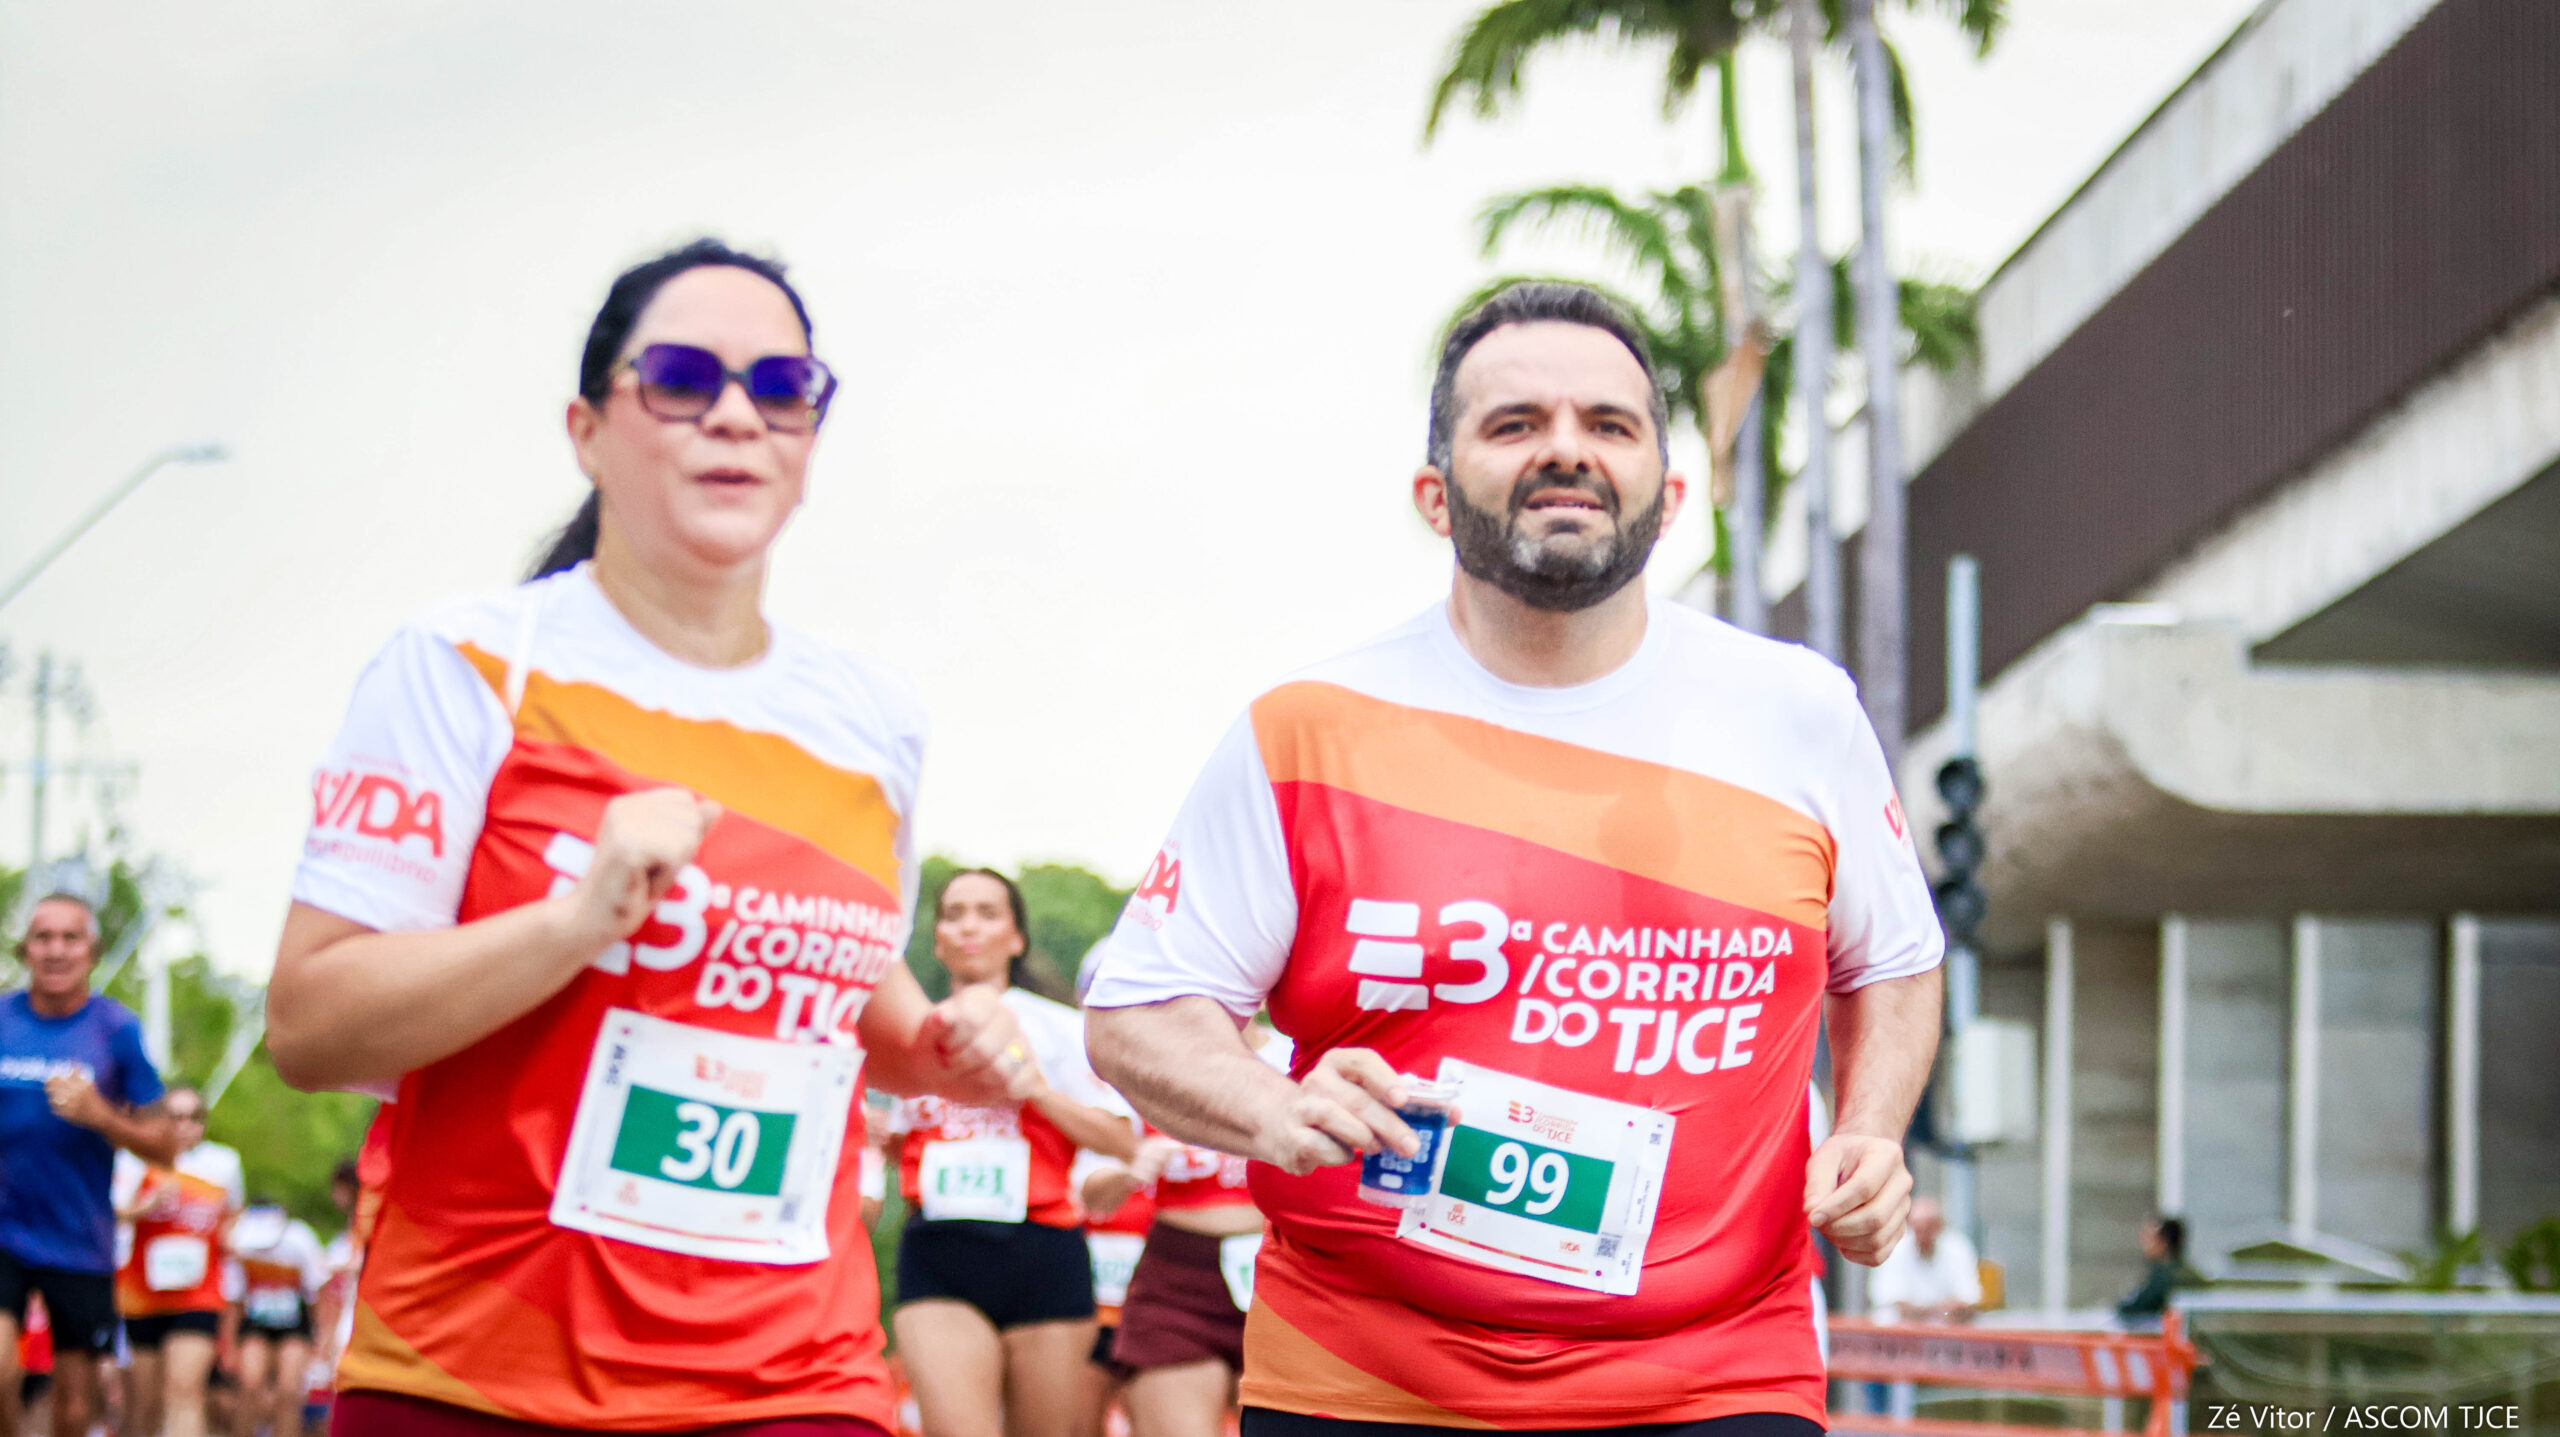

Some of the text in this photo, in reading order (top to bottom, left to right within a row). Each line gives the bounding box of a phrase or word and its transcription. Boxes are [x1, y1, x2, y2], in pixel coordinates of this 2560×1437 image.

[1519, 953, 1775, 1002] /CORRIDA
[1542, 922, 1793, 959] CAMINHADA
[695, 961, 872, 1048] DO TJC
[1510, 998, 1763, 1075] DO TJCE
[660, 1101, 761, 1189] 30
[1485, 1142, 1569, 1215] 99
